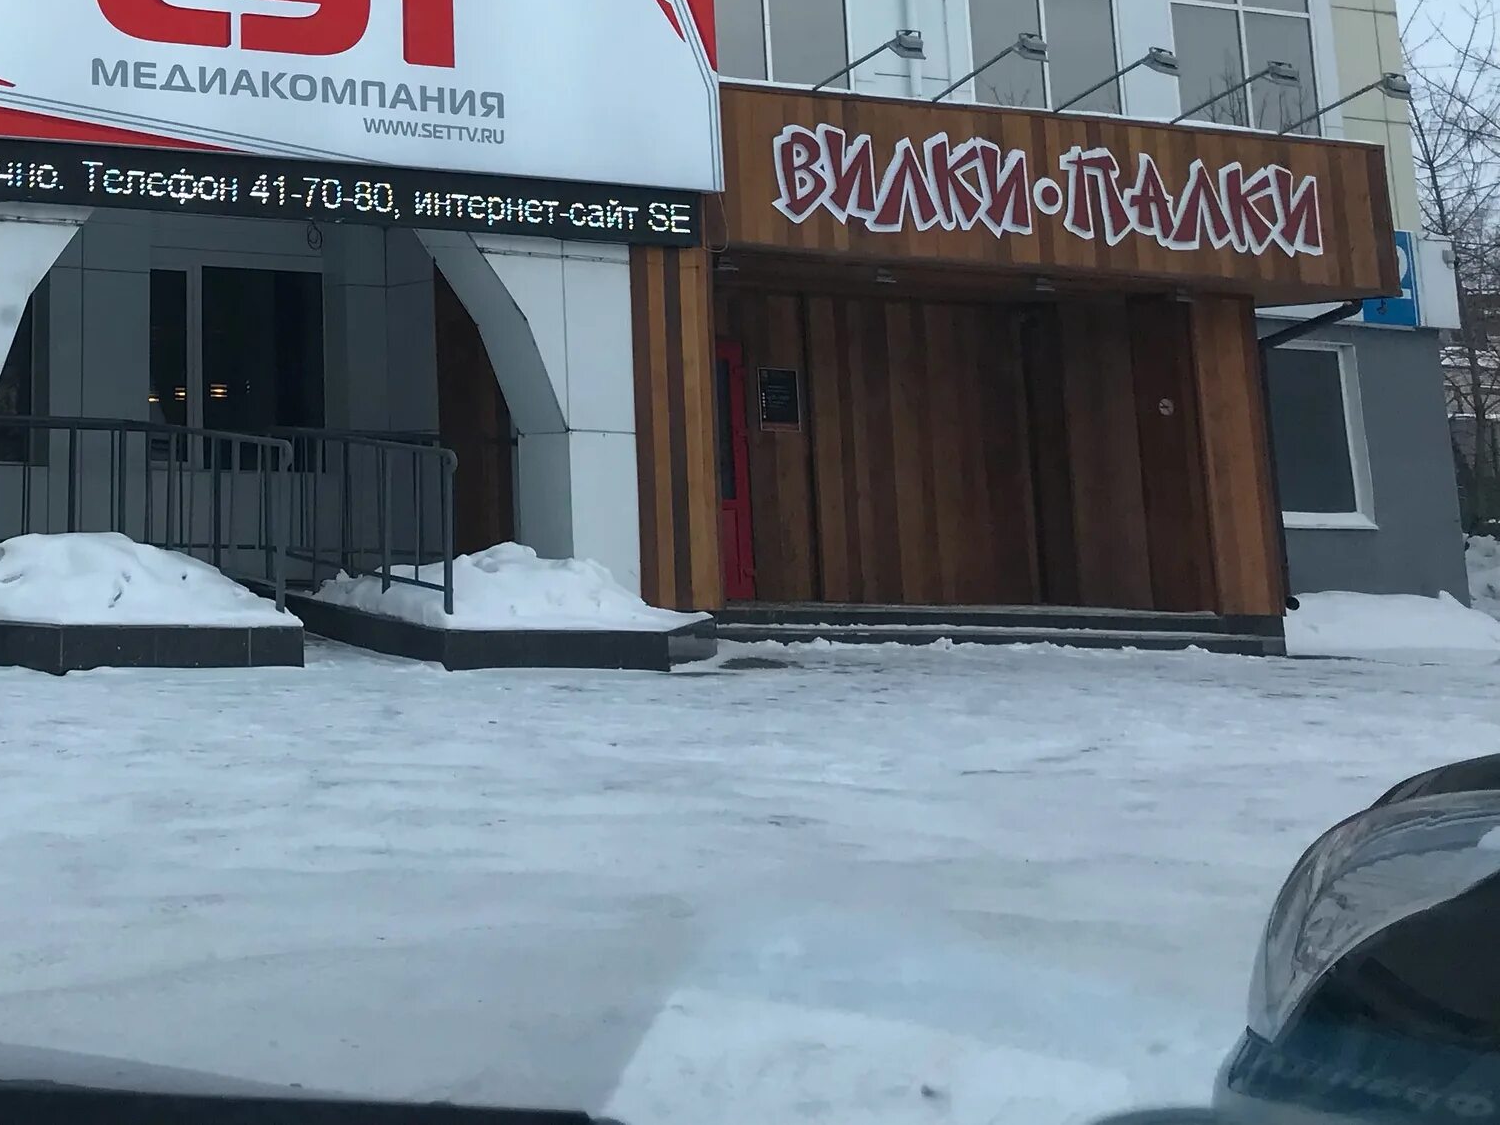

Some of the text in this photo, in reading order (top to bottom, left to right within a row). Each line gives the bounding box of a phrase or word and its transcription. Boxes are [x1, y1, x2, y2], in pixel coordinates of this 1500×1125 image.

[91, 57, 505, 119] МЕДИАКОМПАНИЯ
[363, 117, 505, 145] WWW.SETTV.RU
[82, 160, 238, 206] Телефон
[249, 173, 401, 220] 41-70-80,
[414, 190, 639, 231] интернет-сайт
[647, 201, 692, 234] SE
